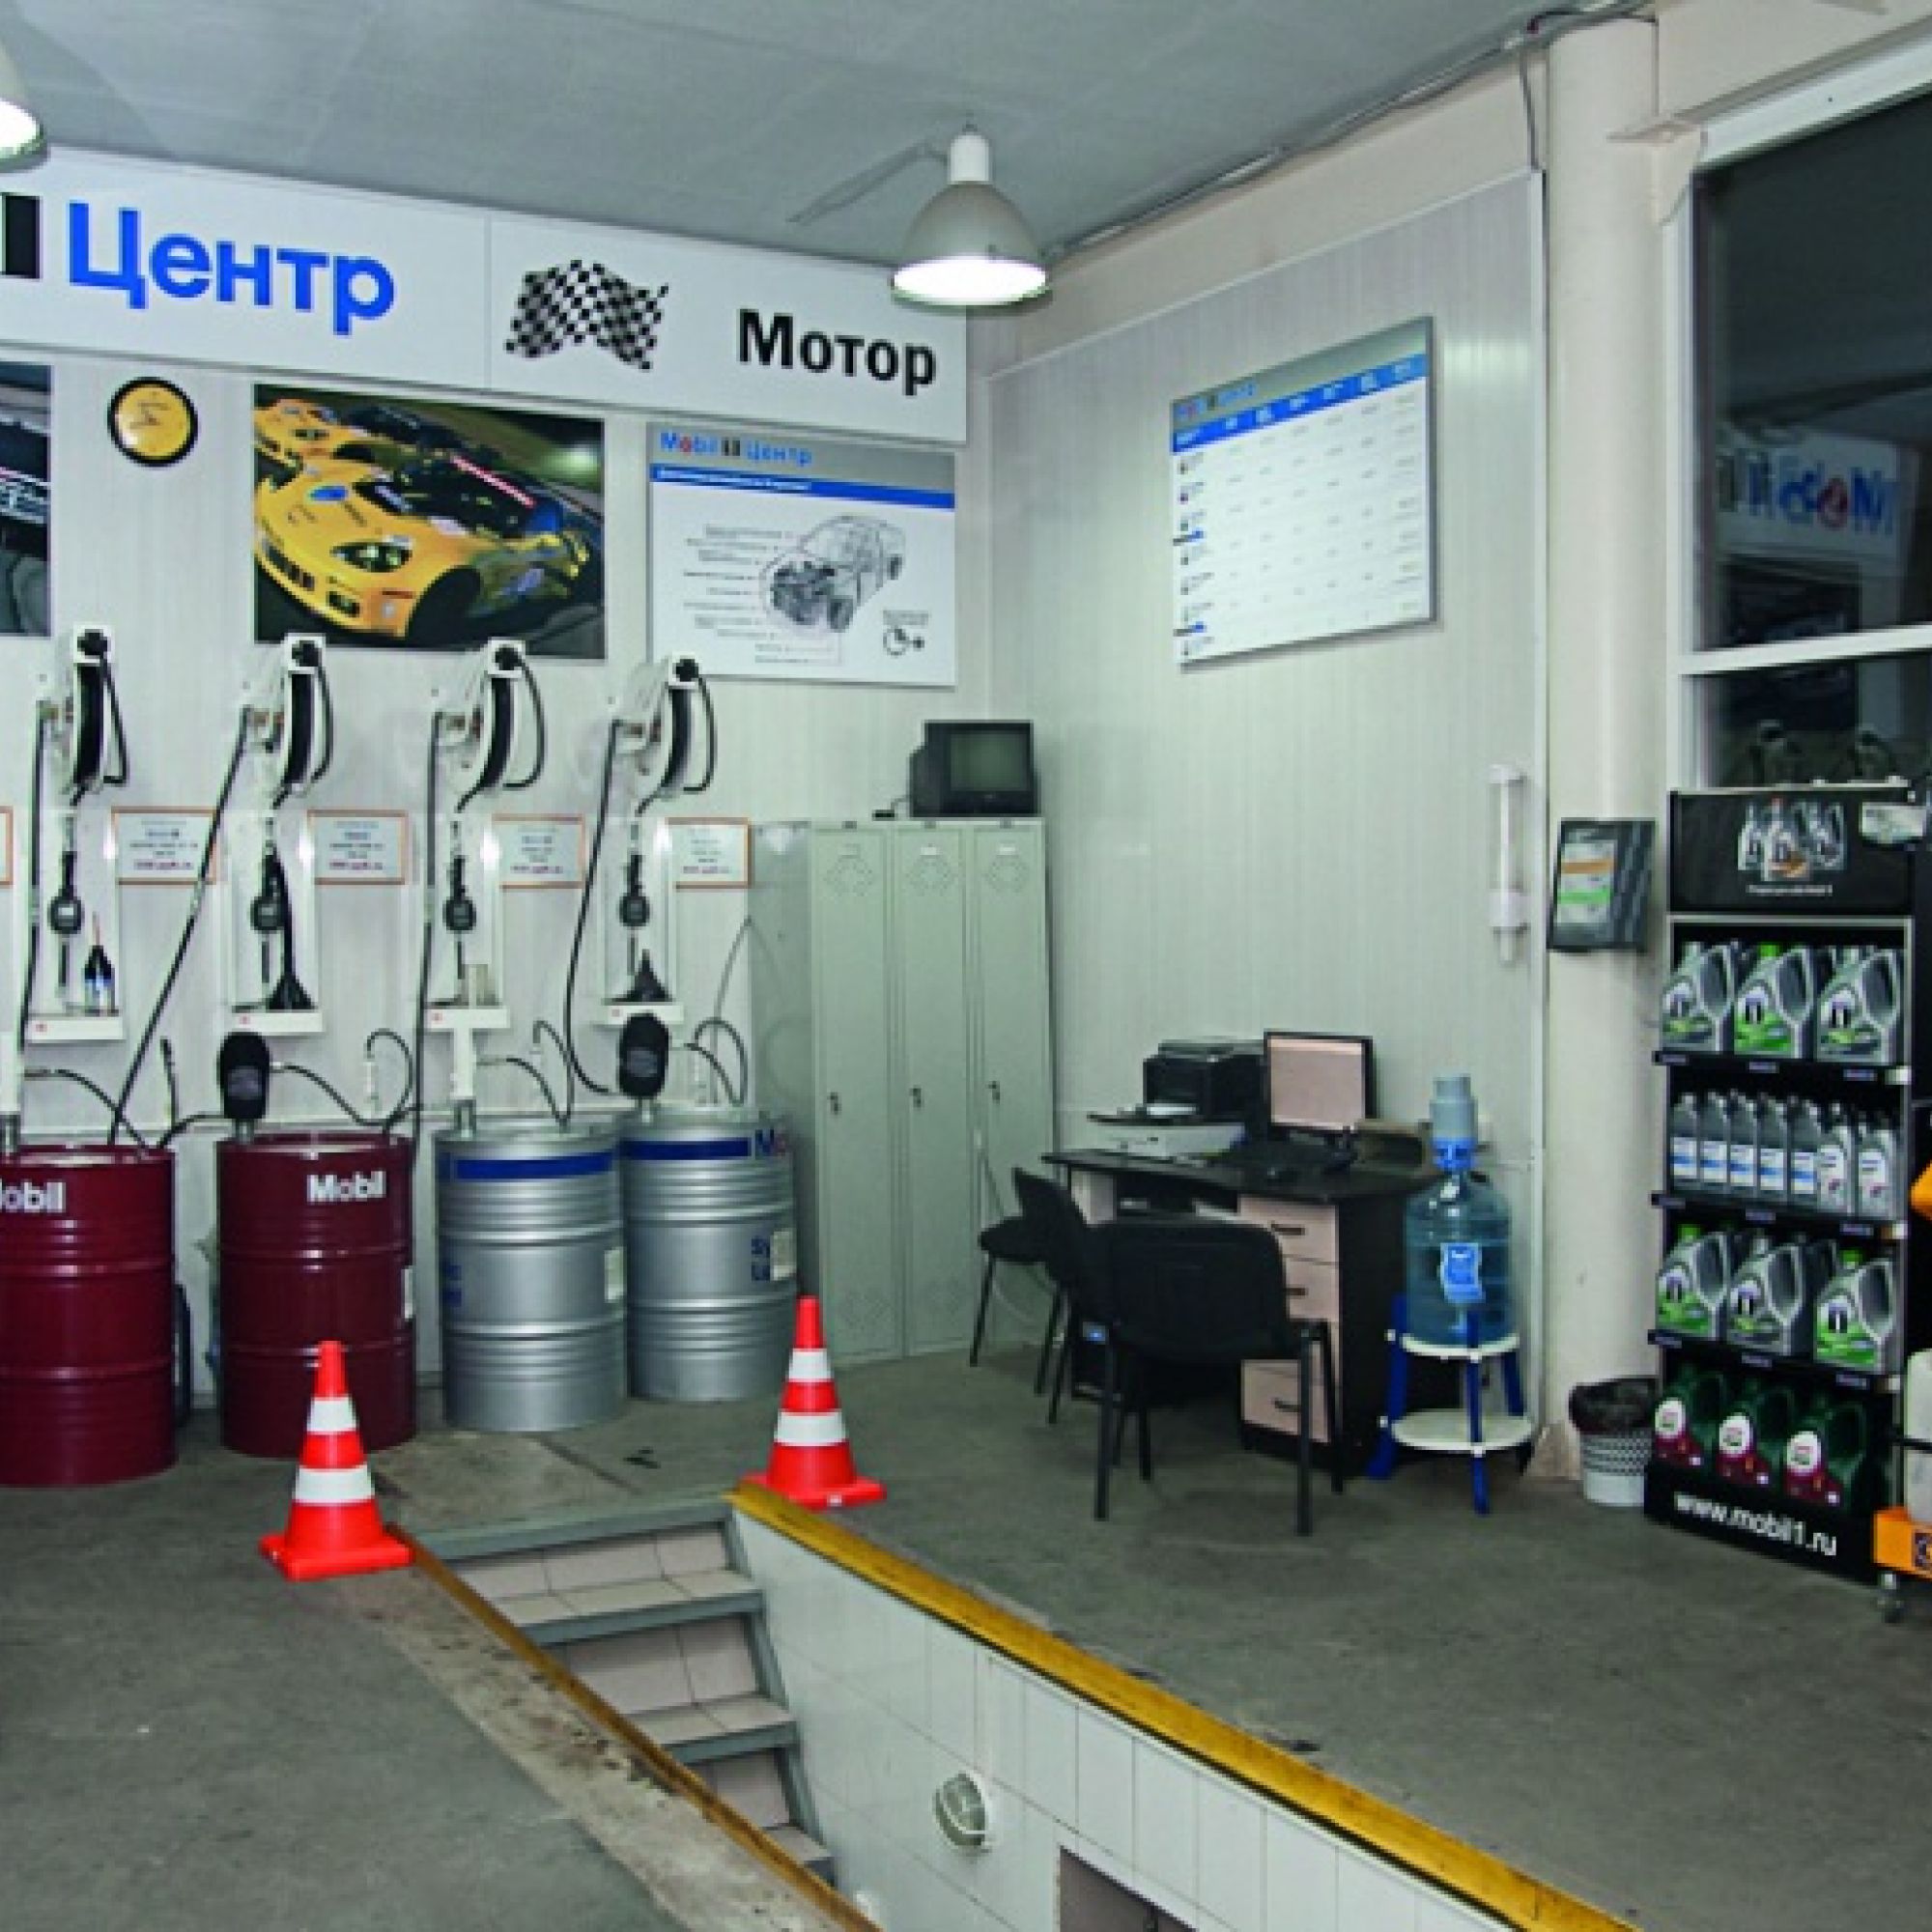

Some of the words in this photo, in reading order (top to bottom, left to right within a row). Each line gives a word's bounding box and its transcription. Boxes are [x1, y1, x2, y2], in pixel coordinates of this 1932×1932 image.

[69, 201, 395, 337] Центр
[737, 306, 936, 397] Мотор
[0, 1179, 66, 1213] obil
[306, 1169, 386, 1205] Mobil
[1674, 1492, 1837, 1557] www.mobil1.ru
